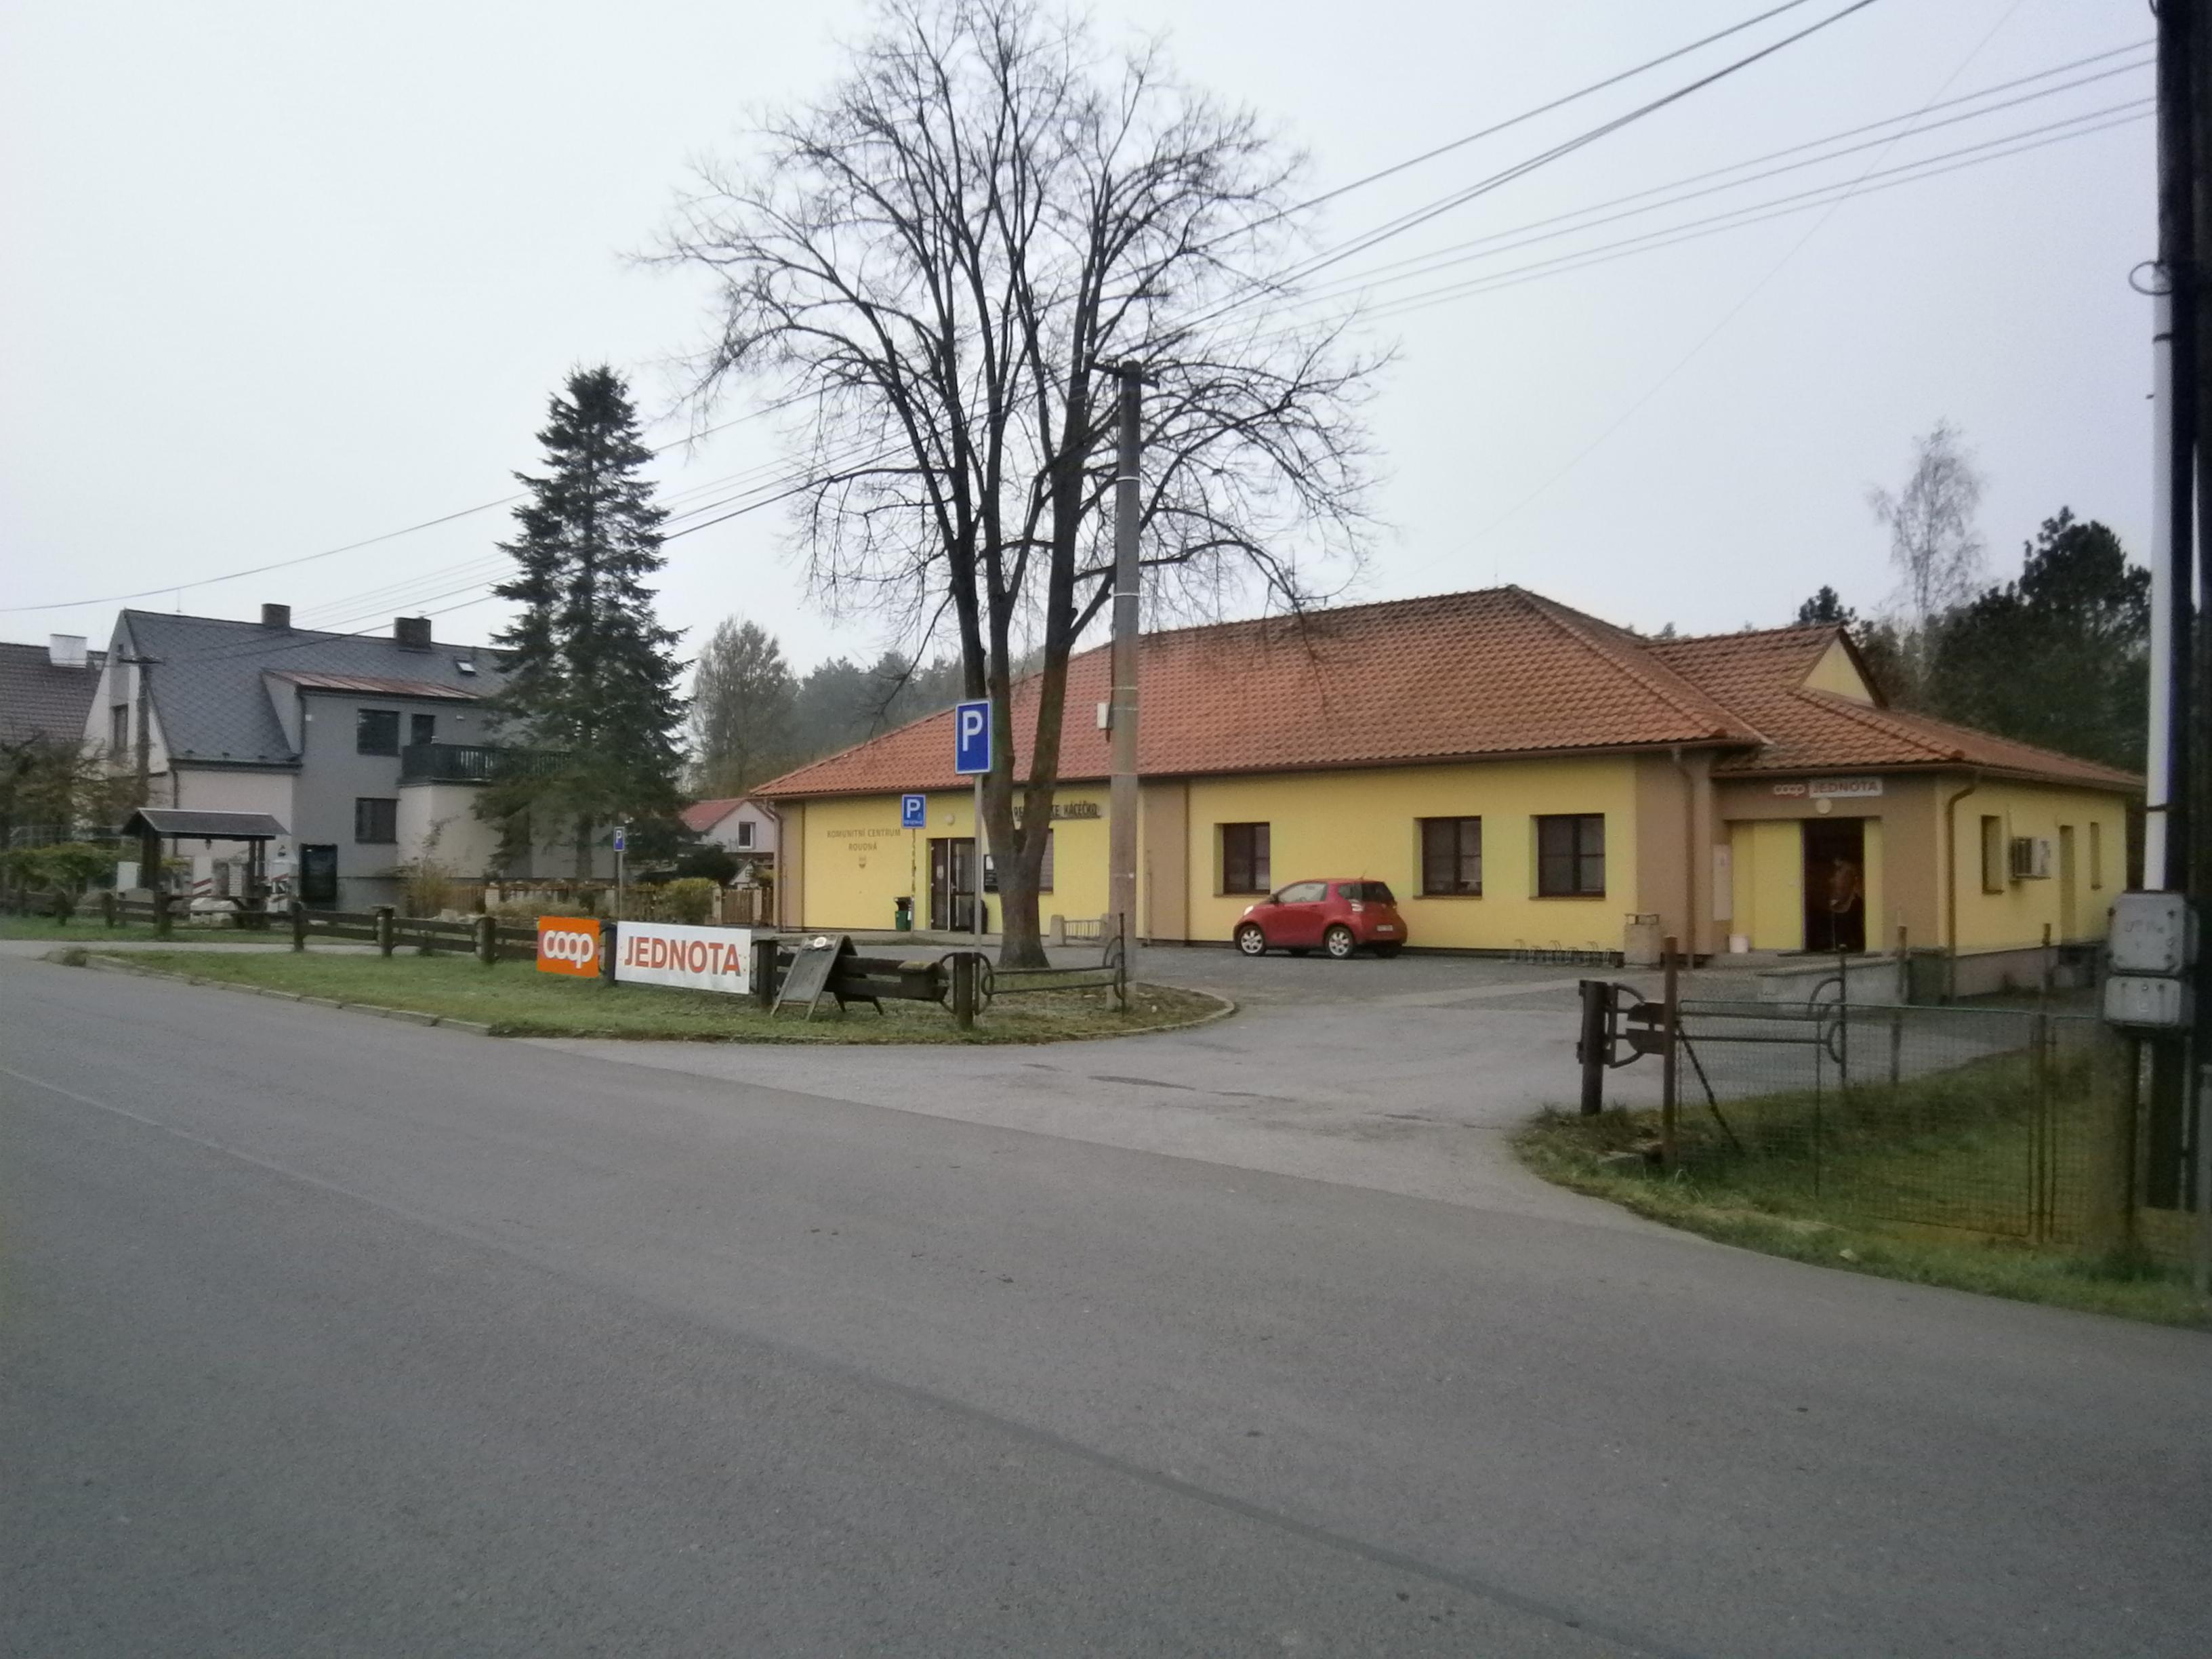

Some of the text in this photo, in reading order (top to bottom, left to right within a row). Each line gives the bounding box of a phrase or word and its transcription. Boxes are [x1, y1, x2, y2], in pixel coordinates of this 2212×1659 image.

[962, 710, 983, 752] P
[1812, 781, 1877, 794] JEDNOTA
[907, 799, 920, 818] P
[616, 830, 622, 843] P
[867, 828, 901, 837] CENTRUM
[543, 930, 594, 969] coop
[624, 936, 741, 977] JEDNOTA
